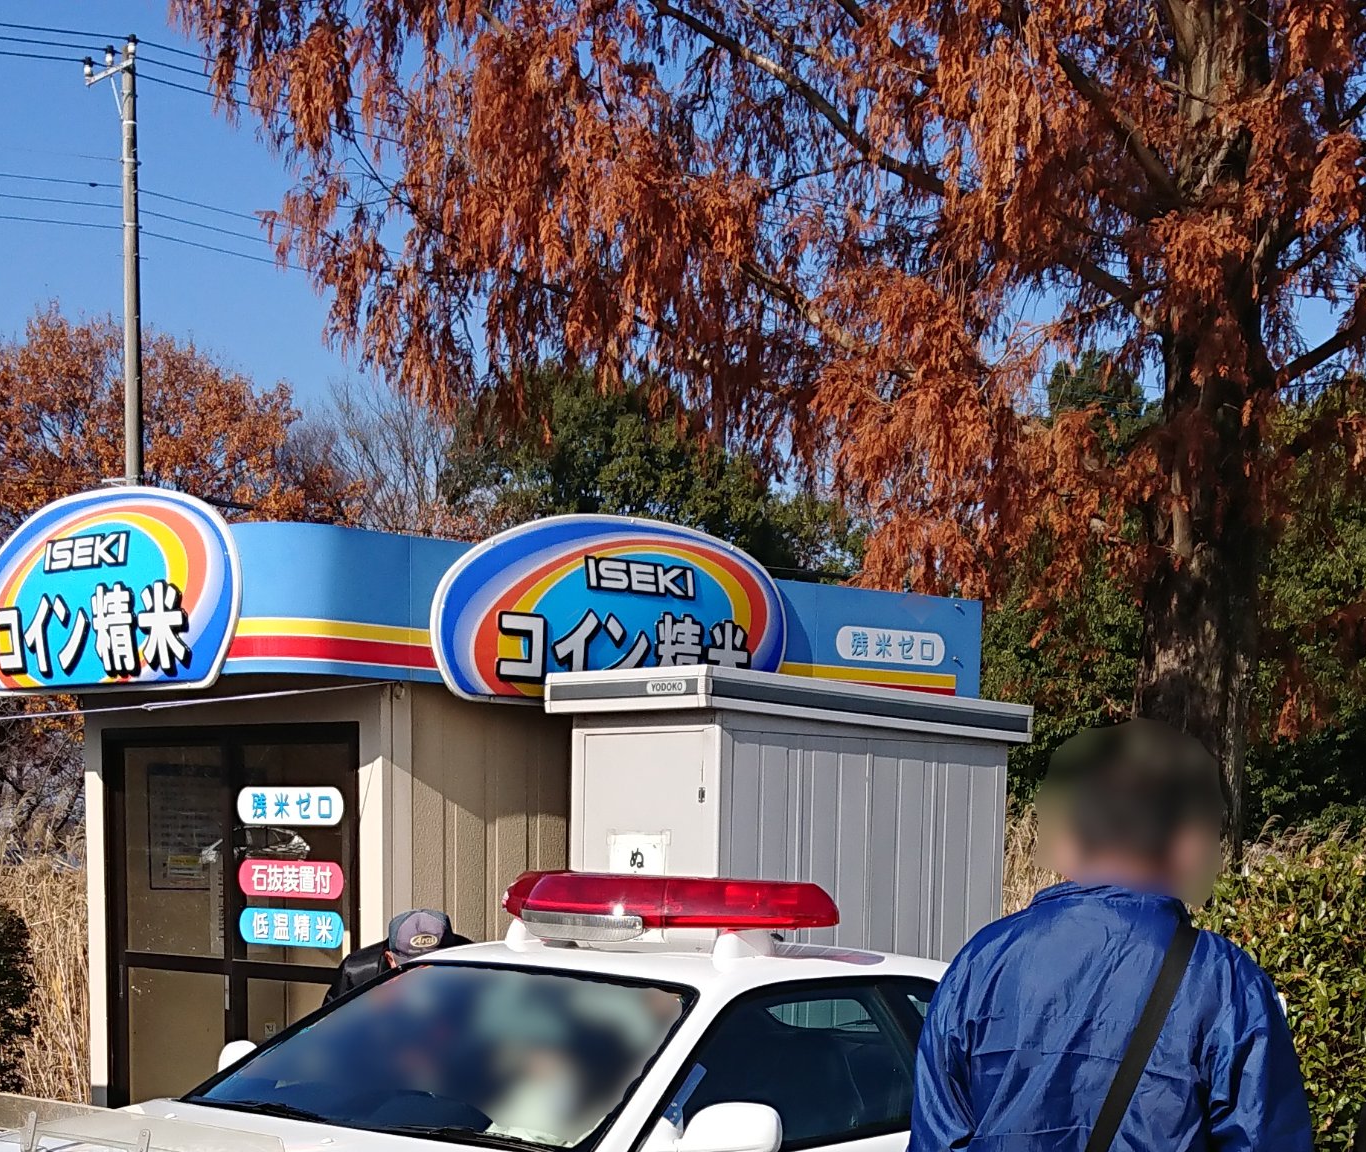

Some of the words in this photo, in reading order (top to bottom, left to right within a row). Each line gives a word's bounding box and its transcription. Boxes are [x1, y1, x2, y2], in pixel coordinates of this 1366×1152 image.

[44, 531, 129, 572] ISEKI
[586, 556, 694, 598] ISEKI
[851, 631, 934, 661] 残米ゼロ
[650, 682, 683, 693] YODOKO
[251, 792, 333, 819] 残米ゼロ
[251, 864, 333, 894] 石抜装置付
[251, 912, 334, 943] 低温精米
